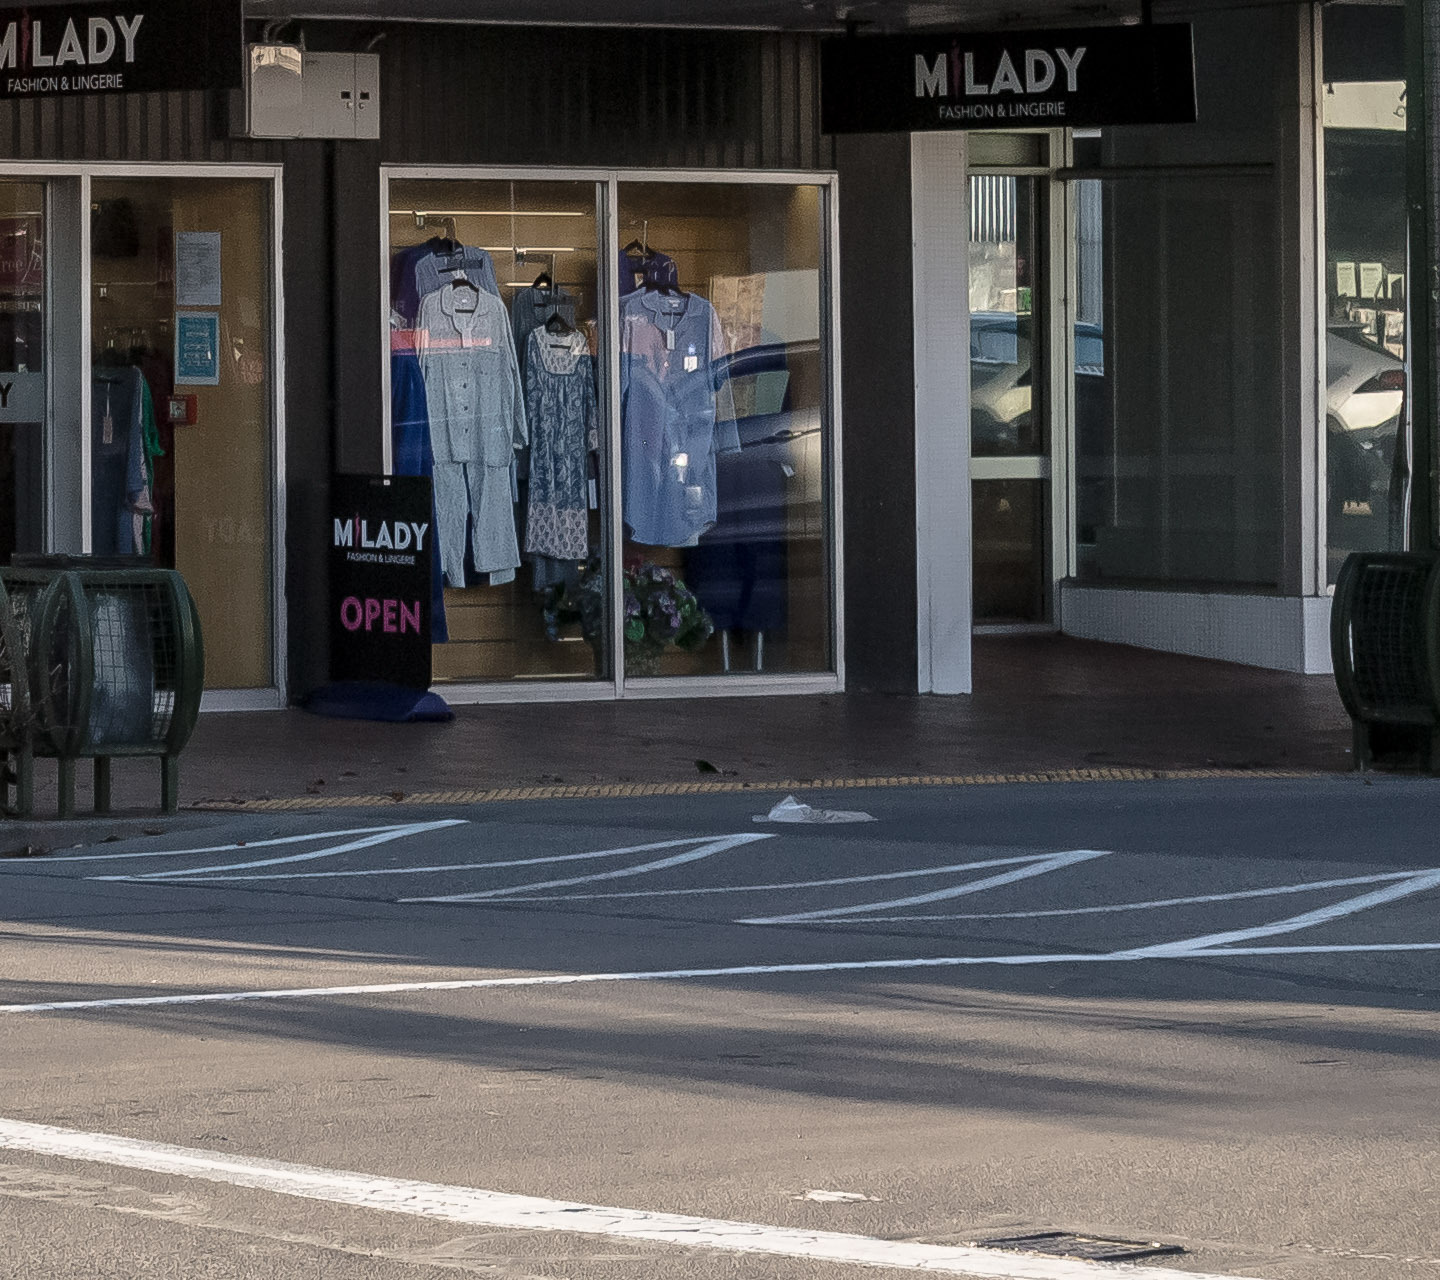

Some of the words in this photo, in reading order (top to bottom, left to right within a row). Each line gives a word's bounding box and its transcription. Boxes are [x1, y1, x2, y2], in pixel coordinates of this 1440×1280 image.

[8, 77, 58, 92] FASHION
[60, 76, 69, 90] &
[72, 74, 123, 89] LINGERIE
[939, 104, 994, 119] FASHION
[997, 103, 1006, 117] &
[1009, 101, 1066, 117] LINGERIE
[346, 551, 378, 562] FASHION
[379, 554, 384, 563] &
[384, 555, 416, 565] LINGERIE
[340, 596, 420, 634] OPEN
